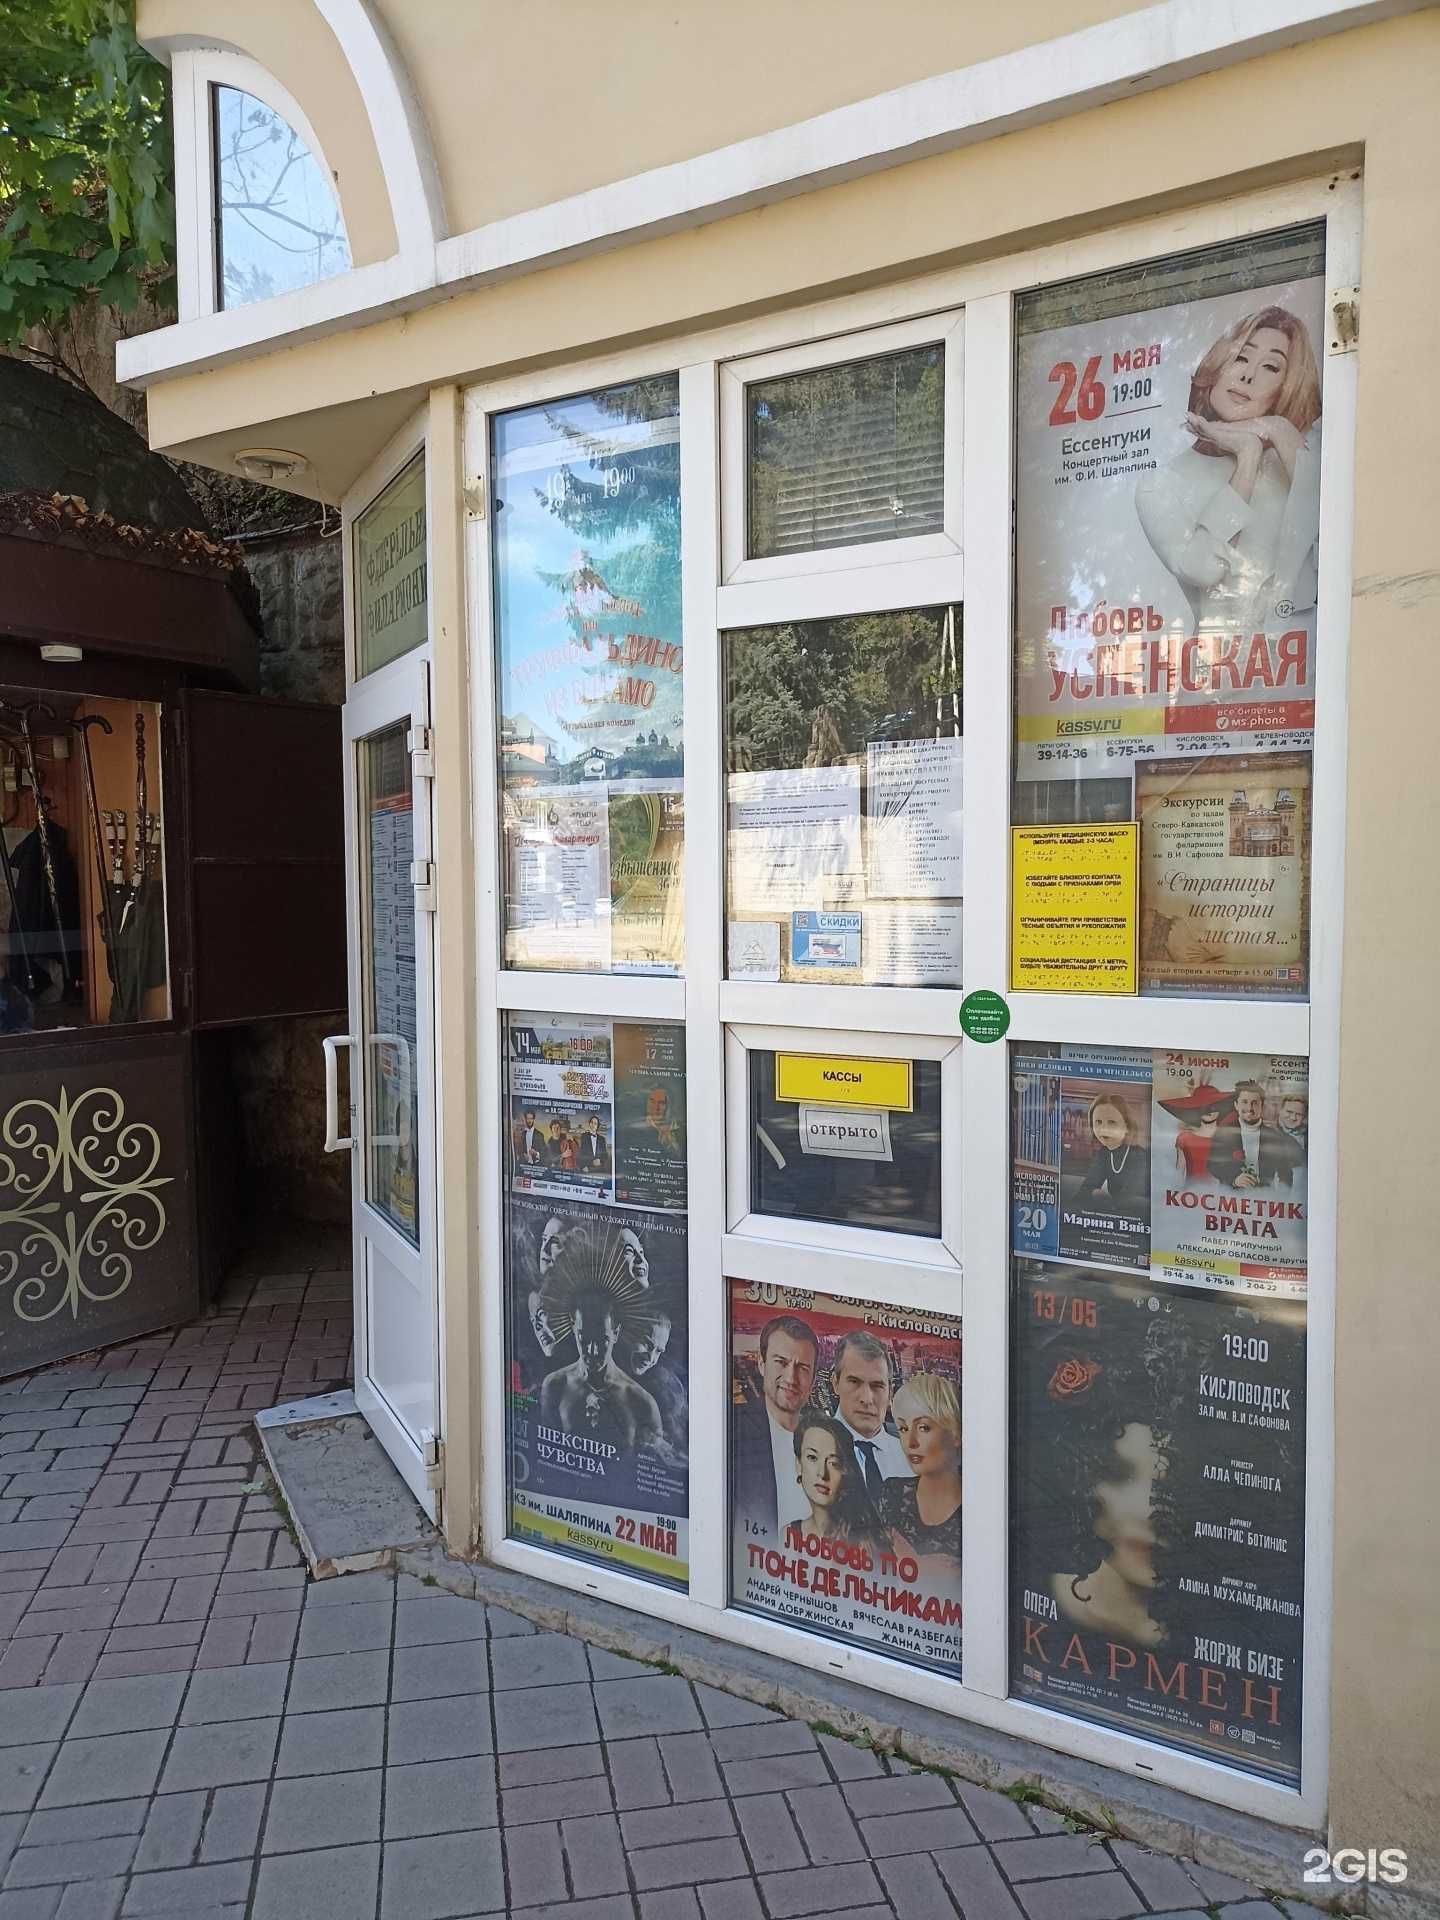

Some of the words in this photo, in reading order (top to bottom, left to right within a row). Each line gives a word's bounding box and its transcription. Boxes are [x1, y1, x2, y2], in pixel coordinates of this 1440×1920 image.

[1113, 344, 1162, 374] мая
[1048, 356, 1106, 427] 26
[1112, 378, 1152, 404] 19:00
[1061, 427, 1151, 456] Ессентуки
[1062, 450, 1128, 471] Концертный
[1131, 448, 1149, 460] зал
[1054, 476, 1072, 486] им.
[1075, 469, 1099, 483] Ф.И.
[1101, 460, 1157, 479] Шаляпина
[1279, 603, 1295, 615] 12+
[1048, 630, 1308, 702] УСПЕНСКАЯ
[1056, 716, 1122, 735] kassy.ru
[1176, 735, 1225, 743] КИСЛОВОДСК
[1037, 748, 1088, 761] 39-14-36
[1160, 796, 1224, 809] Экскурсии
[1061, 831, 1107, 839] МЕДИЦИНСКУЮ
[1096, 837, 1115, 845] ЧАСА)
[1160, 830, 1224, 840] государственной
[1176, 841, 1224, 850] филармонии
[1185, 850, 1224, 860] Сафонова
[1157, 870, 1276, 898] «Страницы
[820, 916, 860, 928] СКИДКИ
[1188, 903, 1273, 921] истории
[1060, 957, 1097, 965] ДИСТАНЦИЯ
[1173, 968, 1202, 977] вторник
[515, 1031, 530, 1054] 14
[1166, 1053, 1185, 1066] 24
[822, 1070, 862, 1083] КАССЫ
[1103, 1069, 1152, 1078] МЕНДЕЛЬСО
[810, 1122, 878, 1140] открыто
[1165, 1189, 1308, 1220] КОСМЕТИК
[1017, 1206, 1047, 1231] 20
[1063, 1212, 1114, 1230] Марина
[1205, 1214, 1279, 1239] ВРАГА
[666, 1226, 687, 1236] ТЕАТР
[1023, 1229, 1041, 1238] МАЯ
[1176, 1244, 1226, 1257] АЛЕКСАНДР
[1228, 1250, 1269, 1262] ОБЛАСОВ
[1201, 1235, 1229, 1246] ПАВЕЛ
[1230, 1240, 1283, 1252] ПРИЛУЧНЫЙ
[1174, 1255, 1216, 1269] kassy.ru
[744, 1281, 777, 1306] 30
[864, 1313, 874, 1325] г.
[1222, 1334, 1269, 1363] 19:00
[1200, 1374, 1291, 1413] КИСЛОВОДСК
[1198, 1403, 1215, 1418] ЗАЛ
[1248, 1413, 1291, 1432] САФОНОВА
[537, 1425, 620, 1461] ШЕКСПИР.
[537, 1443, 606, 1476] ЧУВСТВА
[1203, 1464, 1231, 1483] АЛЛА
[1234, 1471, 1282, 1493] ЧЕПИНОГА
[528, 1500, 544, 1514] им.
[546, 1503, 612, 1536] ШАЛЯПИНА
[656, 1514, 677, 1531] 19:00
[743, 1519, 768, 1537] 16+
[567, 1527, 614, 1553] kassy.ru
[615, 1514, 636, 1543] 22
[639, 1522, 677, 1557] МАЯ
[1194, 1521, 1244, 1544] ДИМИТРИС
[1247, 1531, 1288, 1553] БОТИНИС
[784, 1526, 874, 1572] ЛЮБОВЬ
[880, 1552, 919, 1584] ПО
[746, 1577, 781, 1597] АНДРЕЙ
[783, 1589, 838, 1613] ЧЕРНЫШОВ
[747, 1543, 963, 1629] ПОНЕДЕЛЬНИКАМ
[1178, 1577, 1210, 1597] АЛИНА
[1213, 1584, 1301, 1617] МУХАМЕДЖАНОВА
[745, 1590, 776, 1608] МАРИЯ
[777, 1602, 854, 1631] ДОБРЖИНСКАЯ
[1023, 1589, 1058, 1622] ОПЕРА
[853, 1609, 904, 1633] ВЯЧЕСЛАВ
[881, 1631, 921, 1653] ЖАННА
[1194, 1636, 1241, 1671] ЖОРЖ
[1247, 1649, 1284, 1682] БИЗЕ
[1022, 1615, 1282, 1727] КАРМЕН
